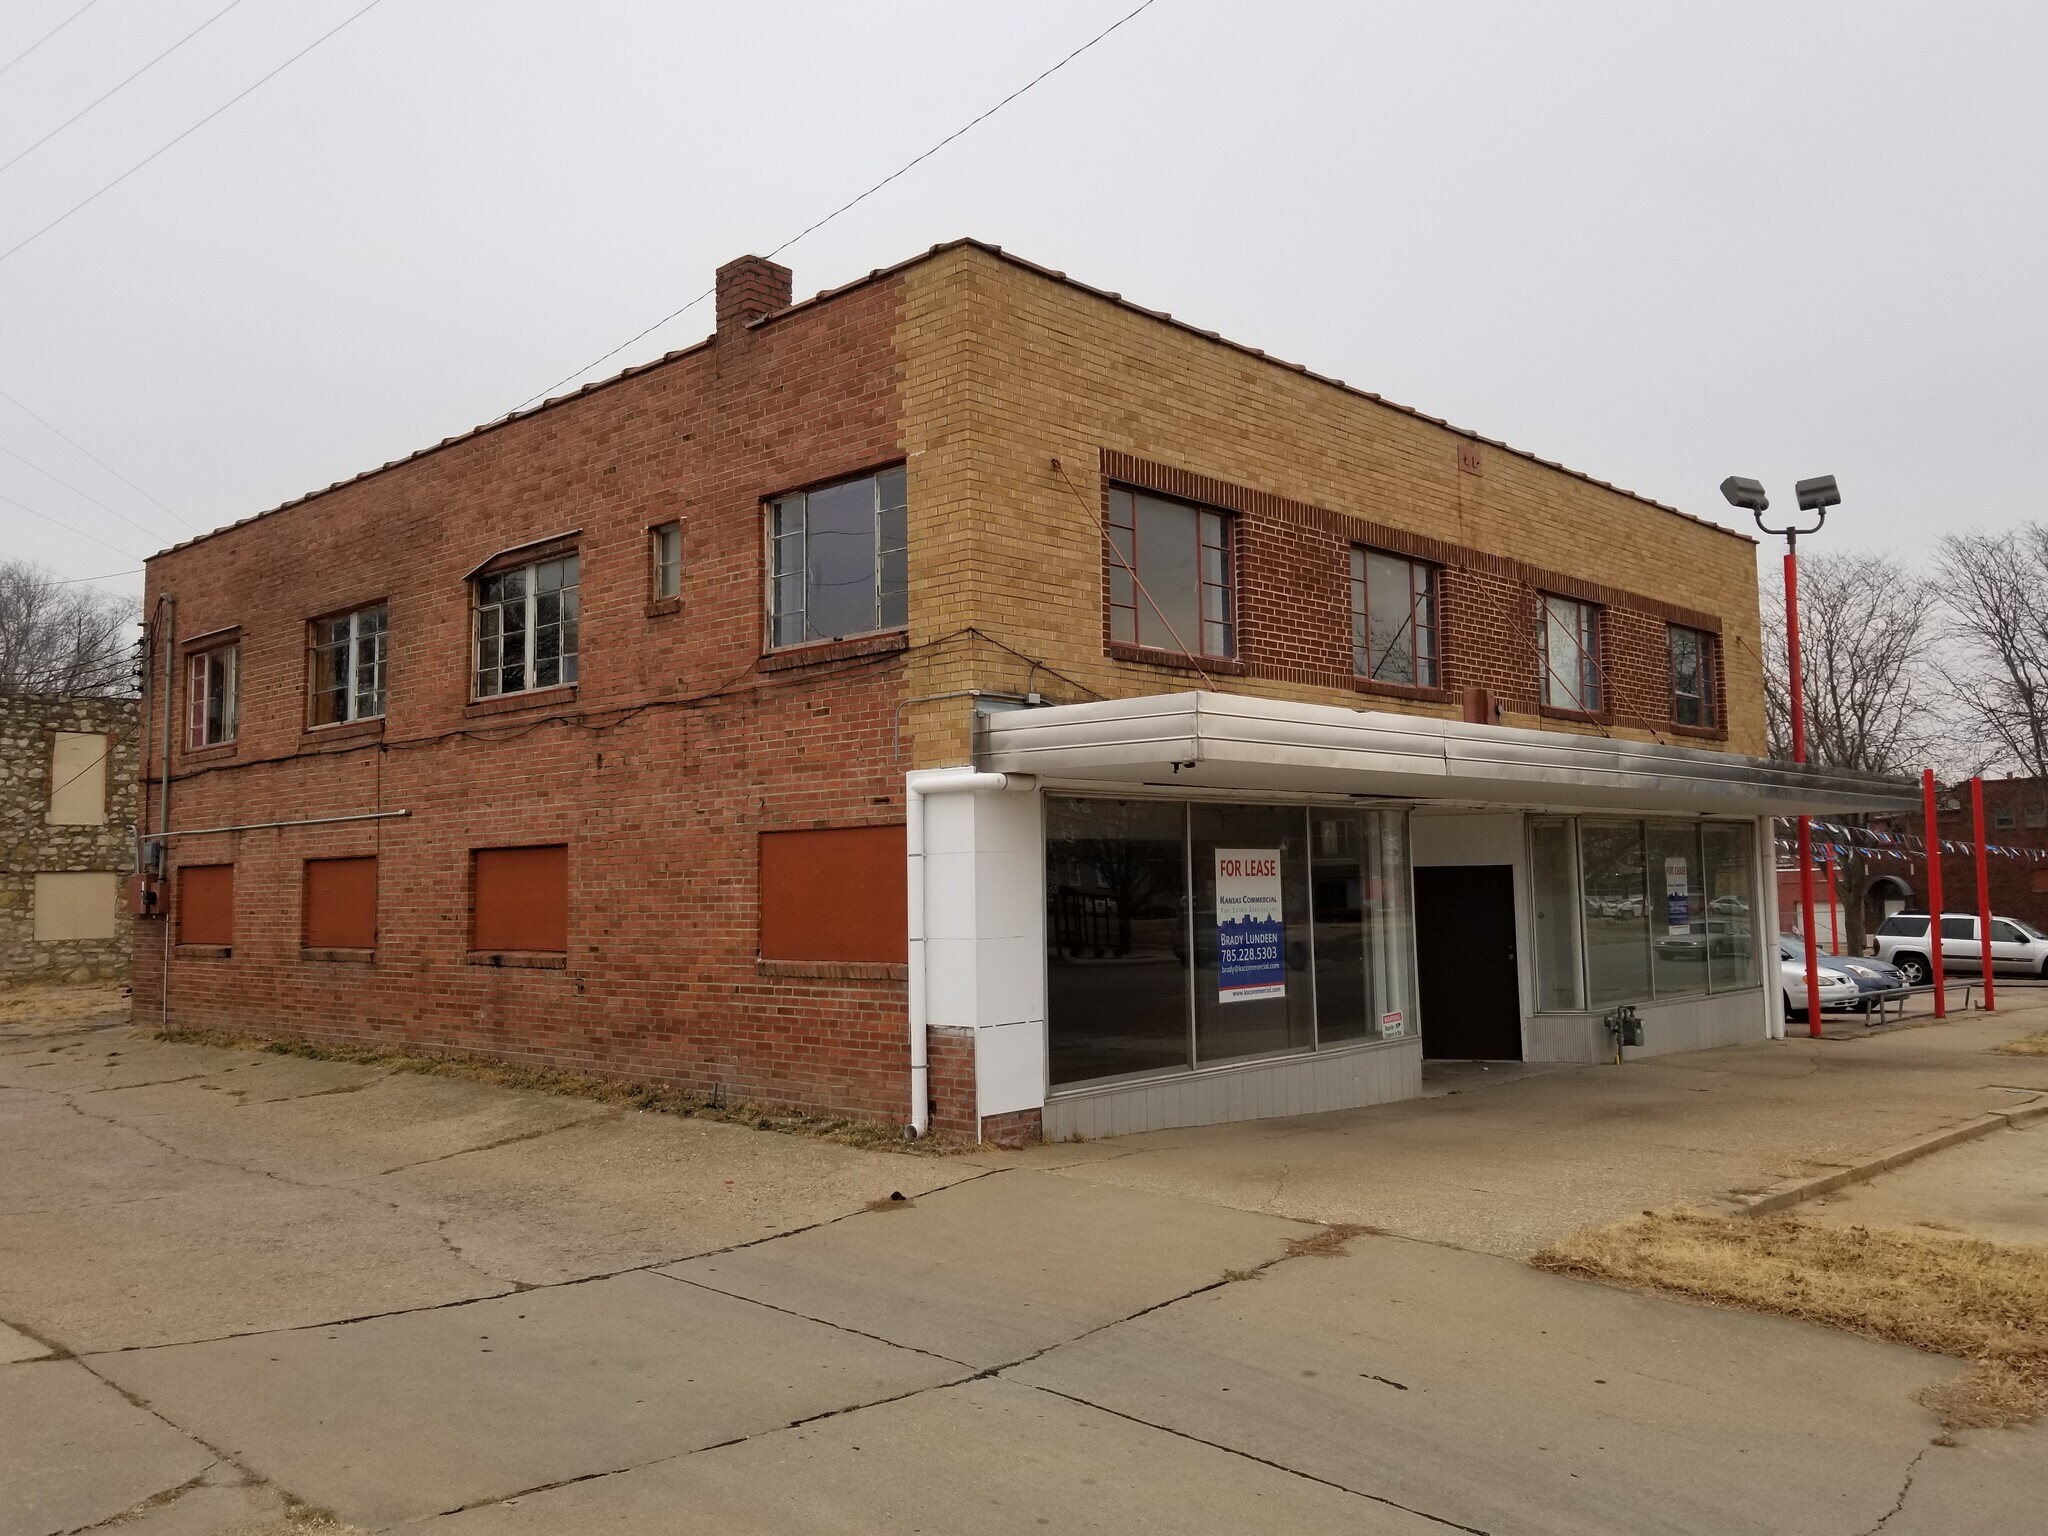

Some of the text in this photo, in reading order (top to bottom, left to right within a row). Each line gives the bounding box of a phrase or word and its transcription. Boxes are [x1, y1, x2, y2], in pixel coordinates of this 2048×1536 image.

[1220, 859, 1276, 877] FOR LEASE
[1221, 932, 1278, 946] BRADY LUNDEEN
[1221, 946, 1278, 962] 785.228.5303
